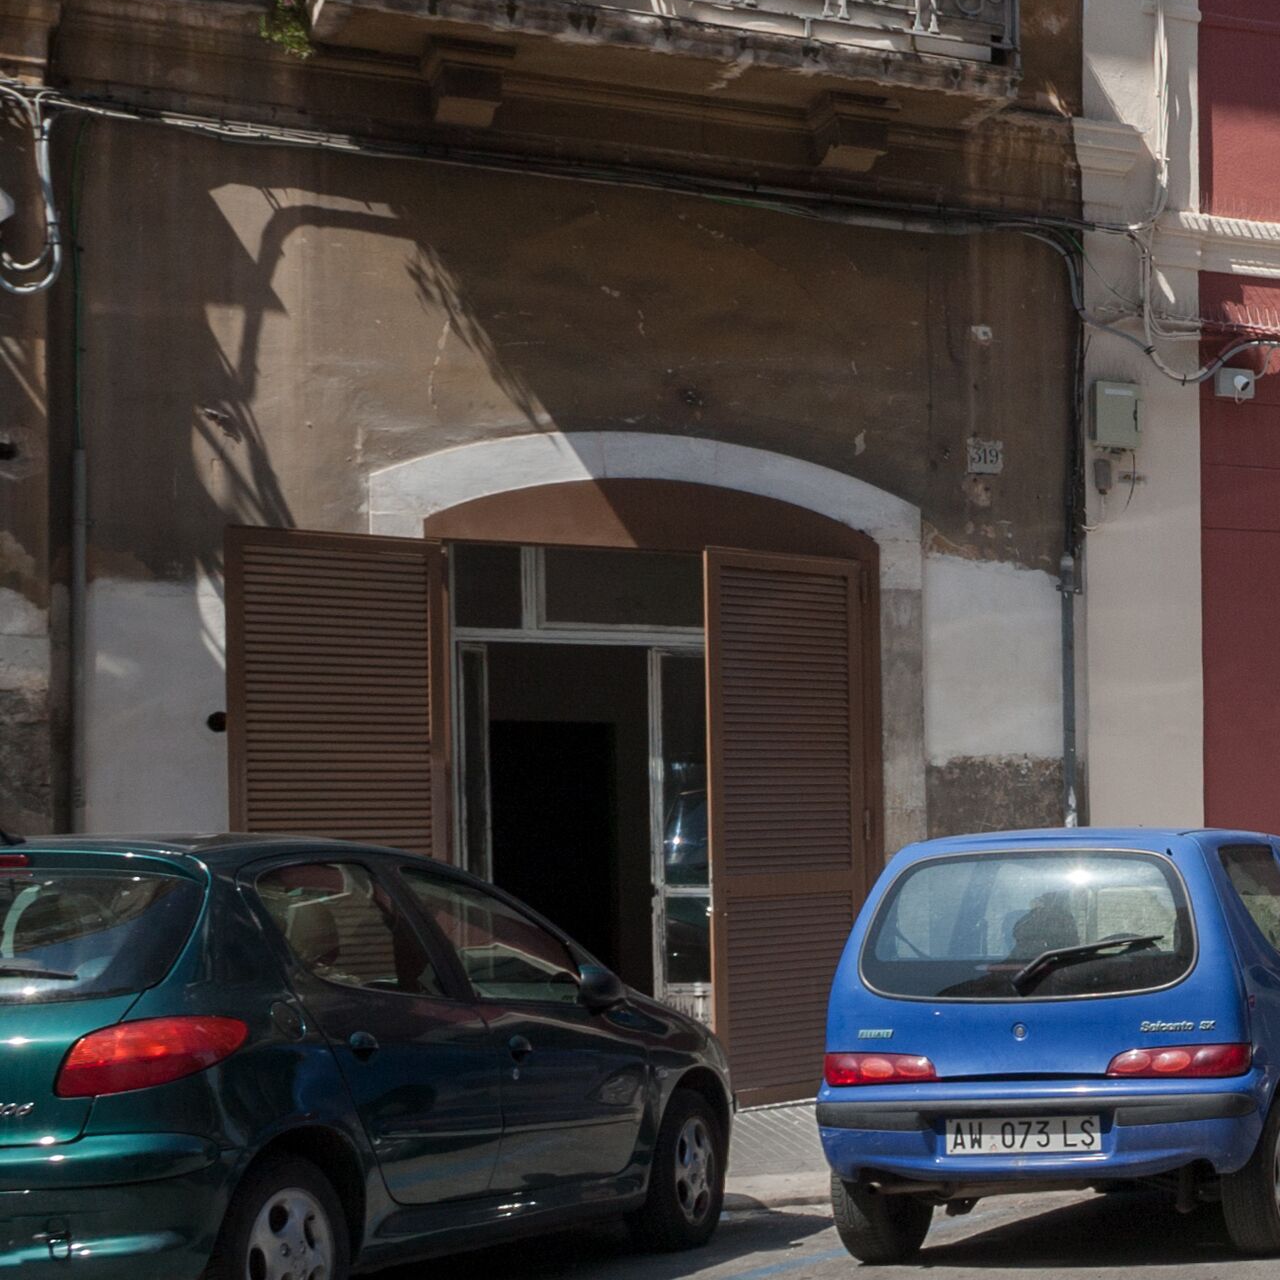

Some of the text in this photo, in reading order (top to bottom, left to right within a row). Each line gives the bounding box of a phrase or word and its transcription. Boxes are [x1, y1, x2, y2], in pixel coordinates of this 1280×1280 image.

[970, 447, 999, 464] 319
[0, 1102, 35, 1116] 06
[953, 1120, 1095, 1150] AW 073 LS
